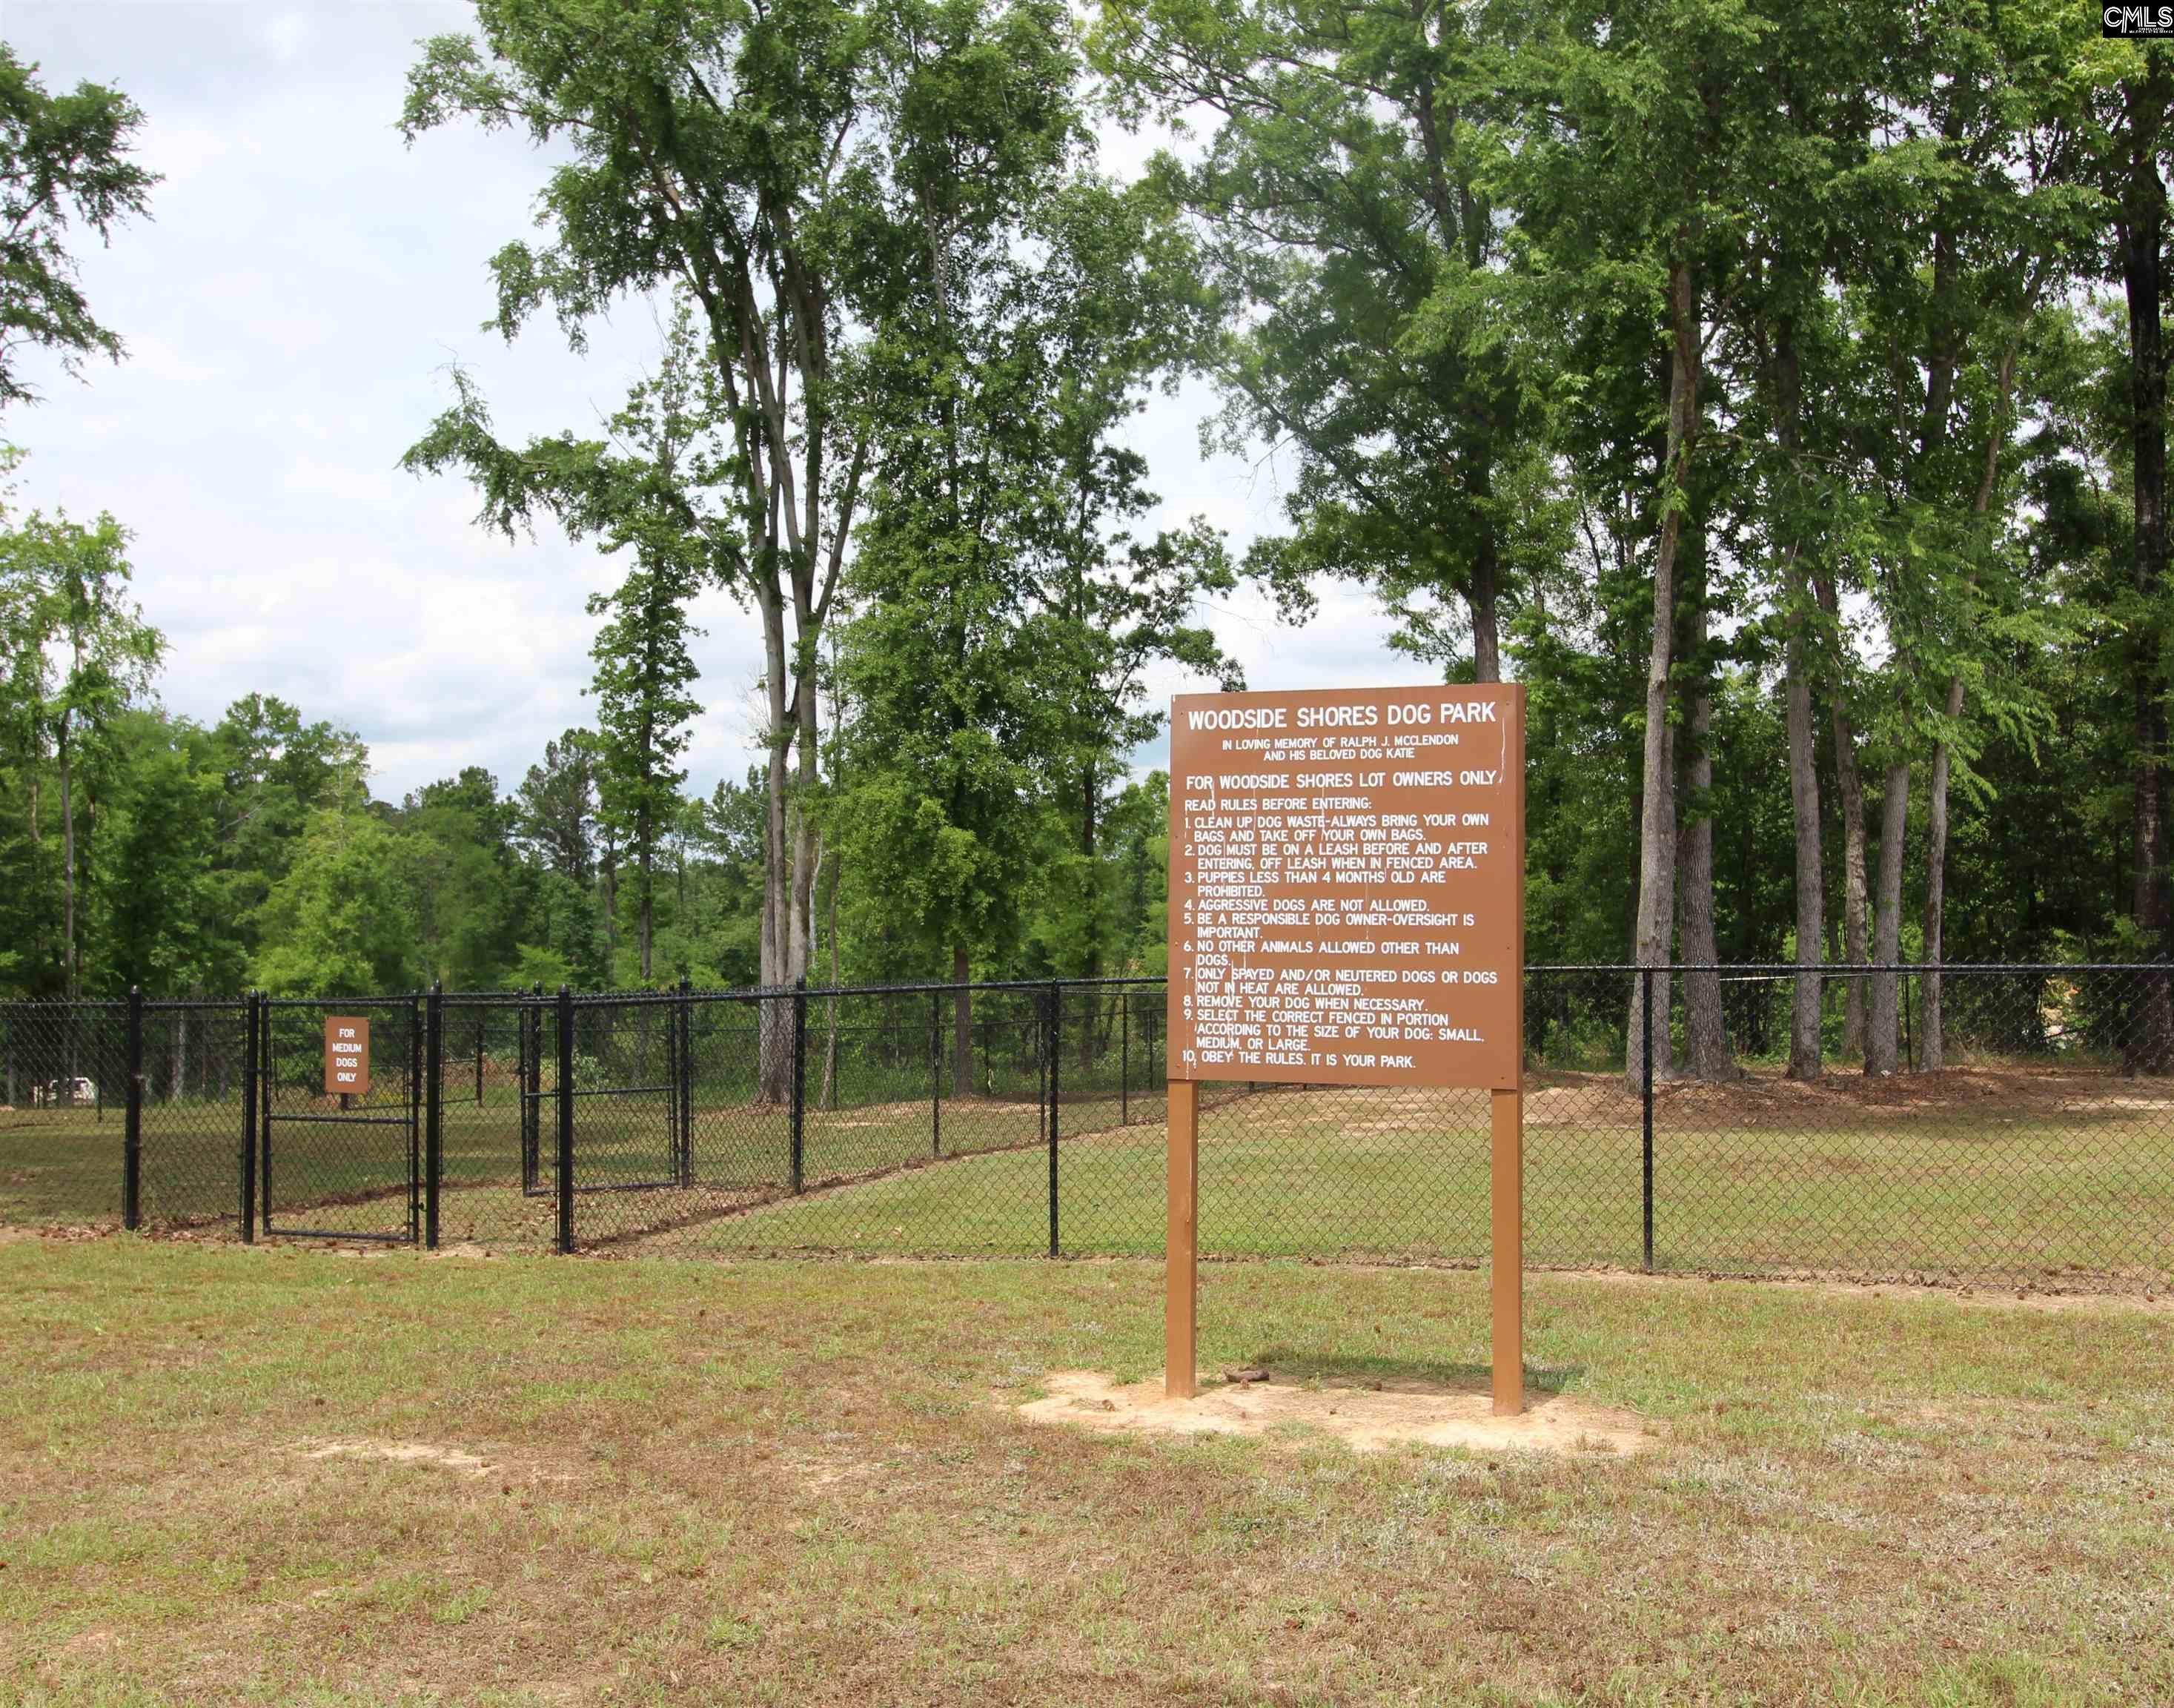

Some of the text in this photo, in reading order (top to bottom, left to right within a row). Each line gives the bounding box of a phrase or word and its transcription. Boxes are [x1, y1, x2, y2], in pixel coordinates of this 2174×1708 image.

[1188, 702, 1496, 730] WOODSIDE SHORES DOG PARK
[1222, 734, 1458, 750] IN LOVING MEMORY OF RALPH J. MCCLENDON
[1264, 747, 1415, 761] AND HIS BELOVED DOG KATIE
[1187, 770, 1497, 790] FOR WOODSIDE SHORES LOT OWNERS ONLY
[1185, 797, 1372, 811] READ RULES BEFORE ENTERING:
[1185, 813, 1488, 829] 1. CLEAN UP DOG WASTE-ALWAYS BRING YOUR OWN
[1194, 829, 1426, 842] BAGS AND TAKE OFF YOUR OWN BAGS.
[1184, 842, 1488, 856] 2. DOG MUST BE ON A LEASH BEFORE AND AFTER
[1260, 858, 1282, 870] OFF
[1288, 858, 1326, 870] LEASH
[1332, 857, 1365, 869] WHEN
[1371, 857, 1381, 869] IN
[1386, 857, 1433, 869] FENCED
[1439, 857, 1477, 869] AREA.
[1184, 871, 1446, 883] 3. PUPPIES LESS THAN 4 MONTHS OLD ARE
[1198, 886, 1265, 897] PROHIBITED.
[1184, 899, 1429, 911] 4. AGGRESSIVE DOGS ARE NOT ALLOWED.
[1184, 913, 1474, 926] 5. BE A RESPONSIBLE DOG OWNER-OVERSIGHT IS
[1198, 927, 1263, 939] IMPORTANT.
[1184, 941, 1459, 955] 6. NO OTHER ANIMALS ALLOWED OTHER THAN
[1197, 954, 1231, 966] DOGS.
[1184, 967, 1497, 984] 7. ONLY SPAYED AND/OR NEUTERED DOGS OR DOGS
[1197, 982, 1364, 996] NOT IN HEAT ARE ALLOWED.
[1184, 996, 1428, 1011] 8. REMOVE YOUR DOG WHEN NECESSARY.
[1184, 1010, 1448, 1026] 9. SELECT THE CORRECT FENCED IN PORTION
[339, 1028, 355, 1038] FOR
[1197, 1024, 1261, 1036] ACCORDING
[1267, 1025, 1281, 1036] TO
[1286, 1025, 1308, 1036] THE
[1314, 1026, 1339, 1037] SIZE
[1345, 1026, 1361, 1038] OF
[1367, 1027, 1399, 1039] YOUR
[1405, 1028, 1434, 1040] DOG:
[332, 1043, 362, 1053] MEDIUM
[1247, 1039, 1263, 1049] OR
[1269, 1039, 1310, 1051] LARGE.
[336, 1058, 357, 1067] DOGS
[1202, 1051, 1233, 1063] OBEY
[1239, 1053, 1262, 1064] THE
[1266, 1053, 1306, 1065] RULES.
[1311, 1053, 1321, 1065] IT
[1327, 1054, 1337, 1065] IS
[1343, 1055, 1375, 1067] YOUR
[1381, 1056, 1416, 1068] PARK.
[337, 1073, 357, 1082] ONLY
